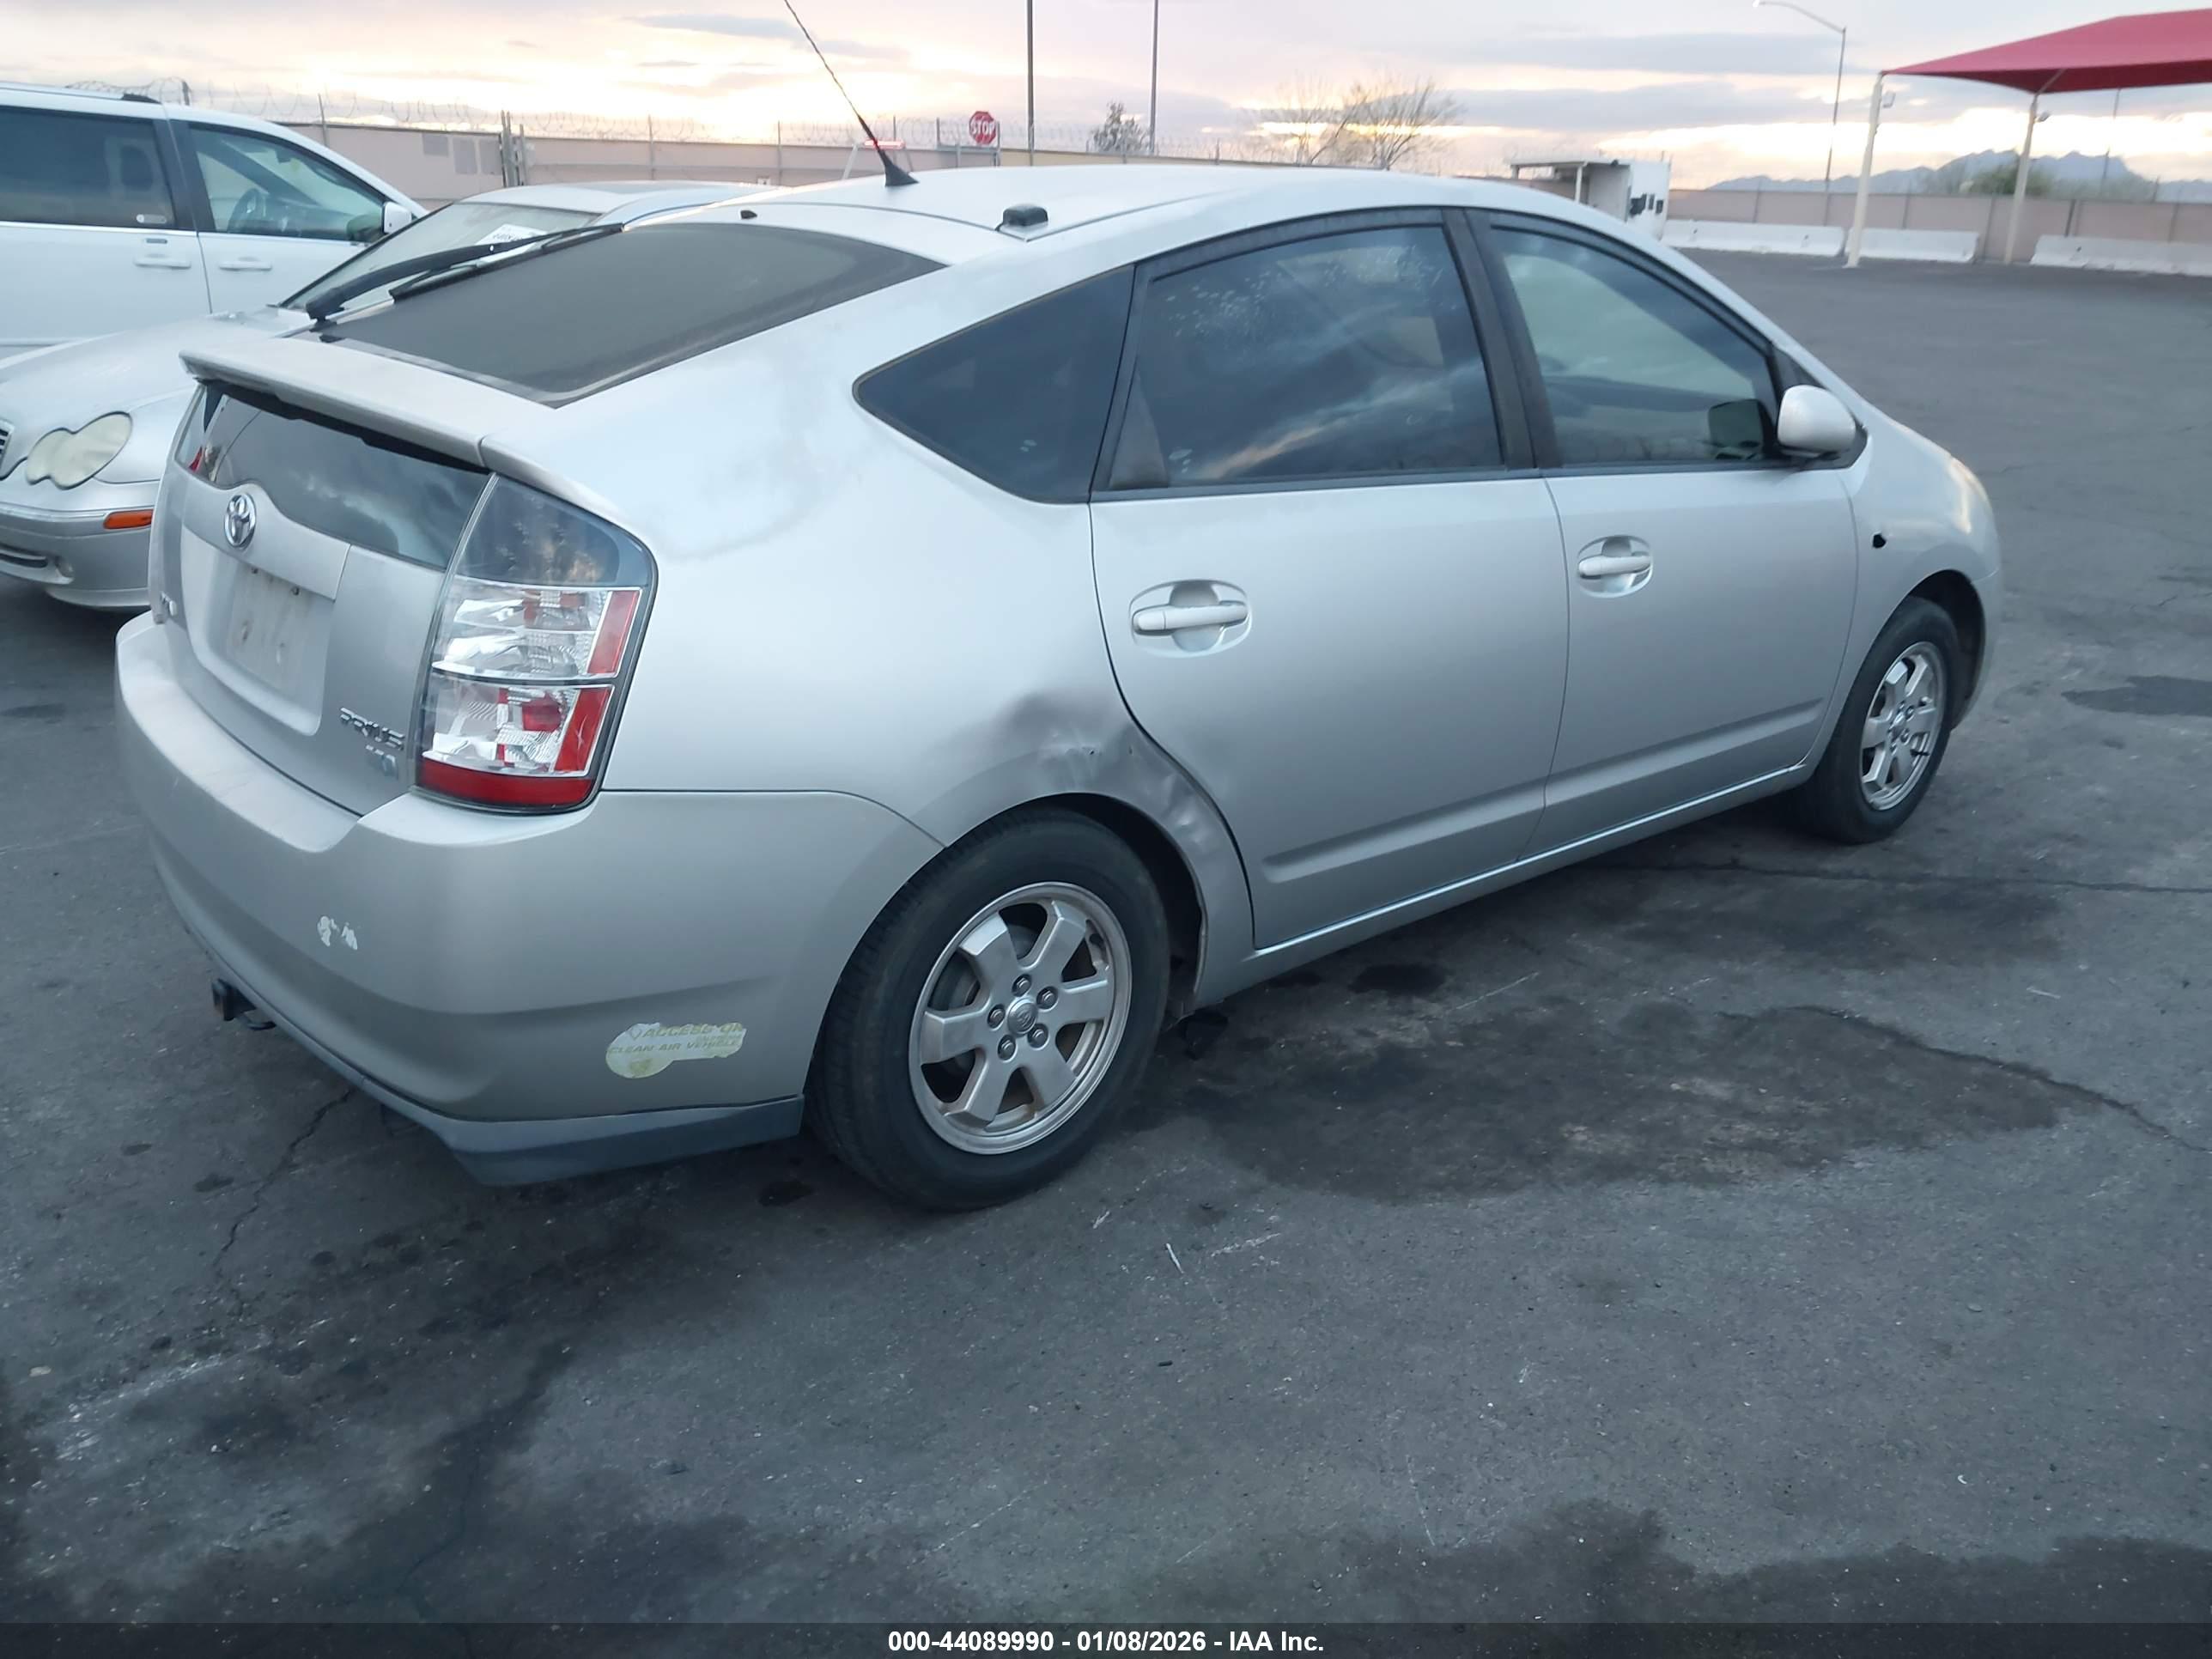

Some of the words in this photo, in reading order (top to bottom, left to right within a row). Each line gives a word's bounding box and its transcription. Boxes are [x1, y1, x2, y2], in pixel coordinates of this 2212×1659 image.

[971, 119, 995, 135] STOP
[340, 707, 404, 750] PRIUS
[659, 1042, 681, 1051] AIR
